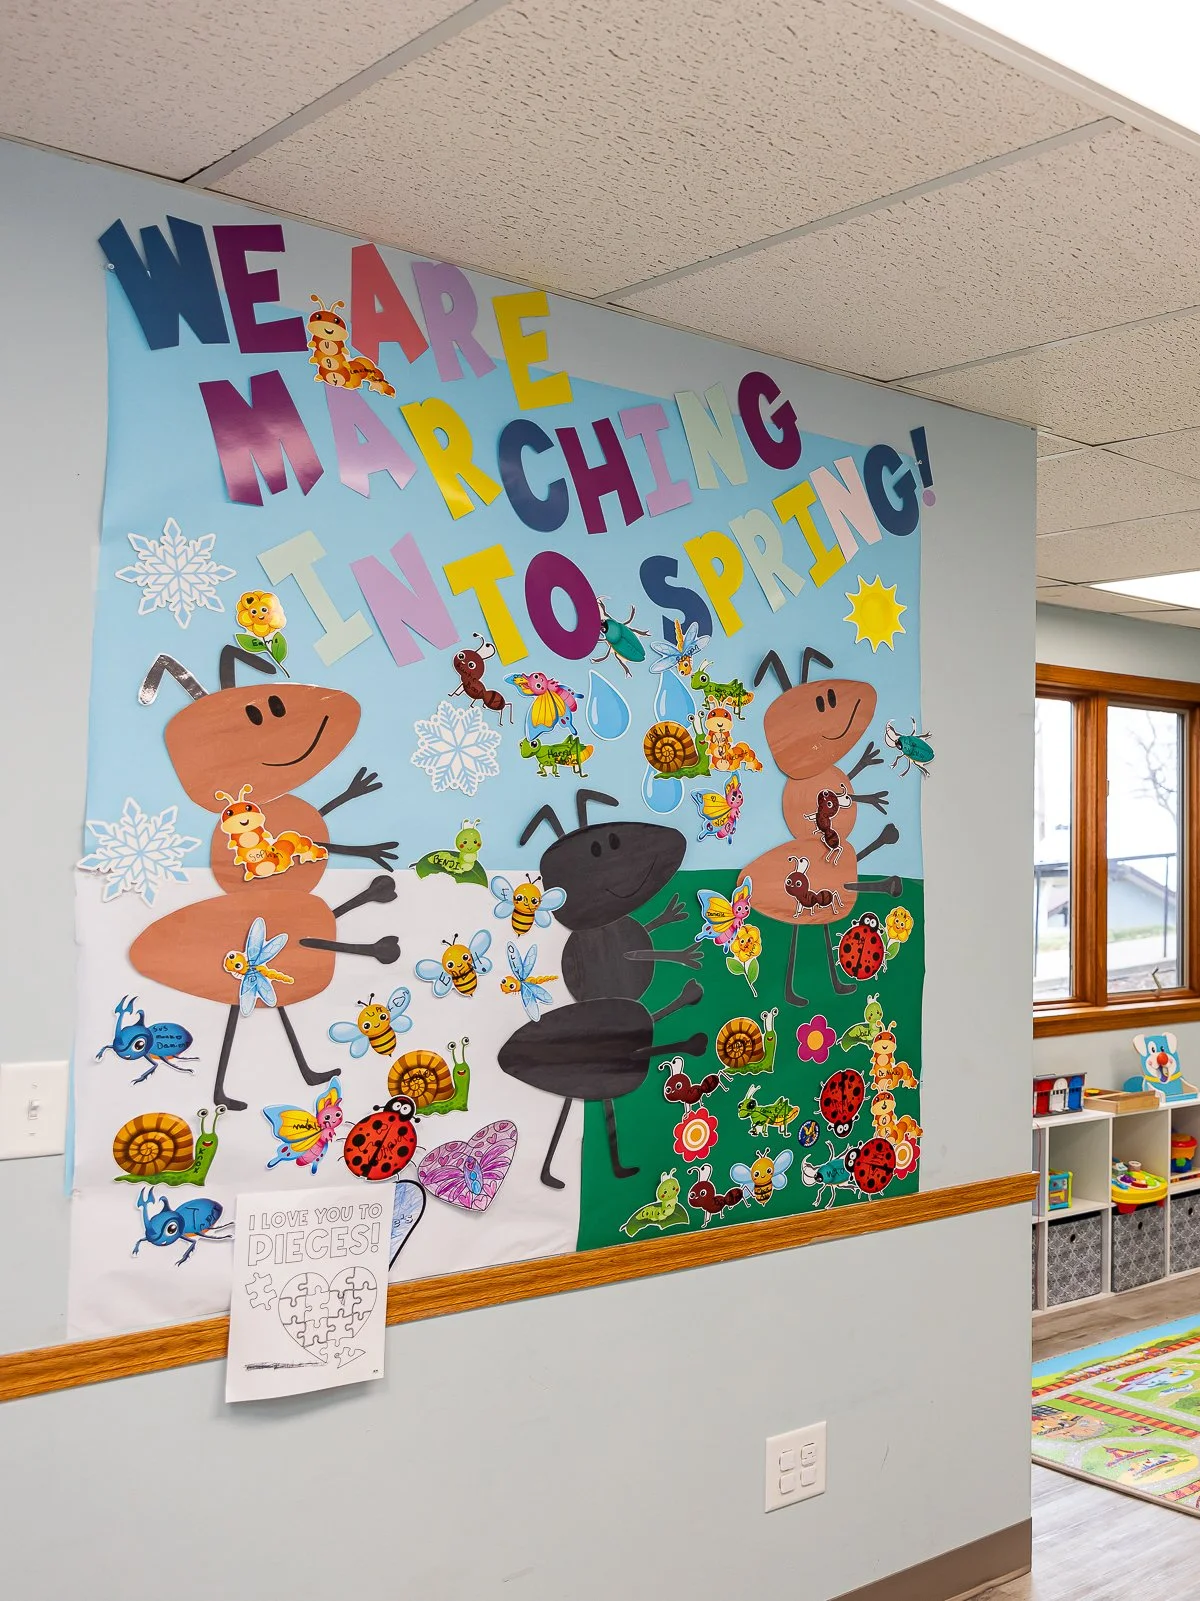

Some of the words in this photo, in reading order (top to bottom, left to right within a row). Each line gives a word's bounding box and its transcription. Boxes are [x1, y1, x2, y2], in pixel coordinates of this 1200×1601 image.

[98, 215, 308, 354] WE
[350, 242, 573, 411] ARE
[198, 371, 802, 534] MARCHING
[256, 531, 603, 667] INTO
[639, 425, 937, 645] SPRING!
[248, 1222, 381, 1266] PIECES!
[249, 1215, 255, 1230] I
[262, 1210, 308, 1229] LOVE
[314, 1206, 353, 1224] YOU
[359, 1203, 383, 1219] TO
